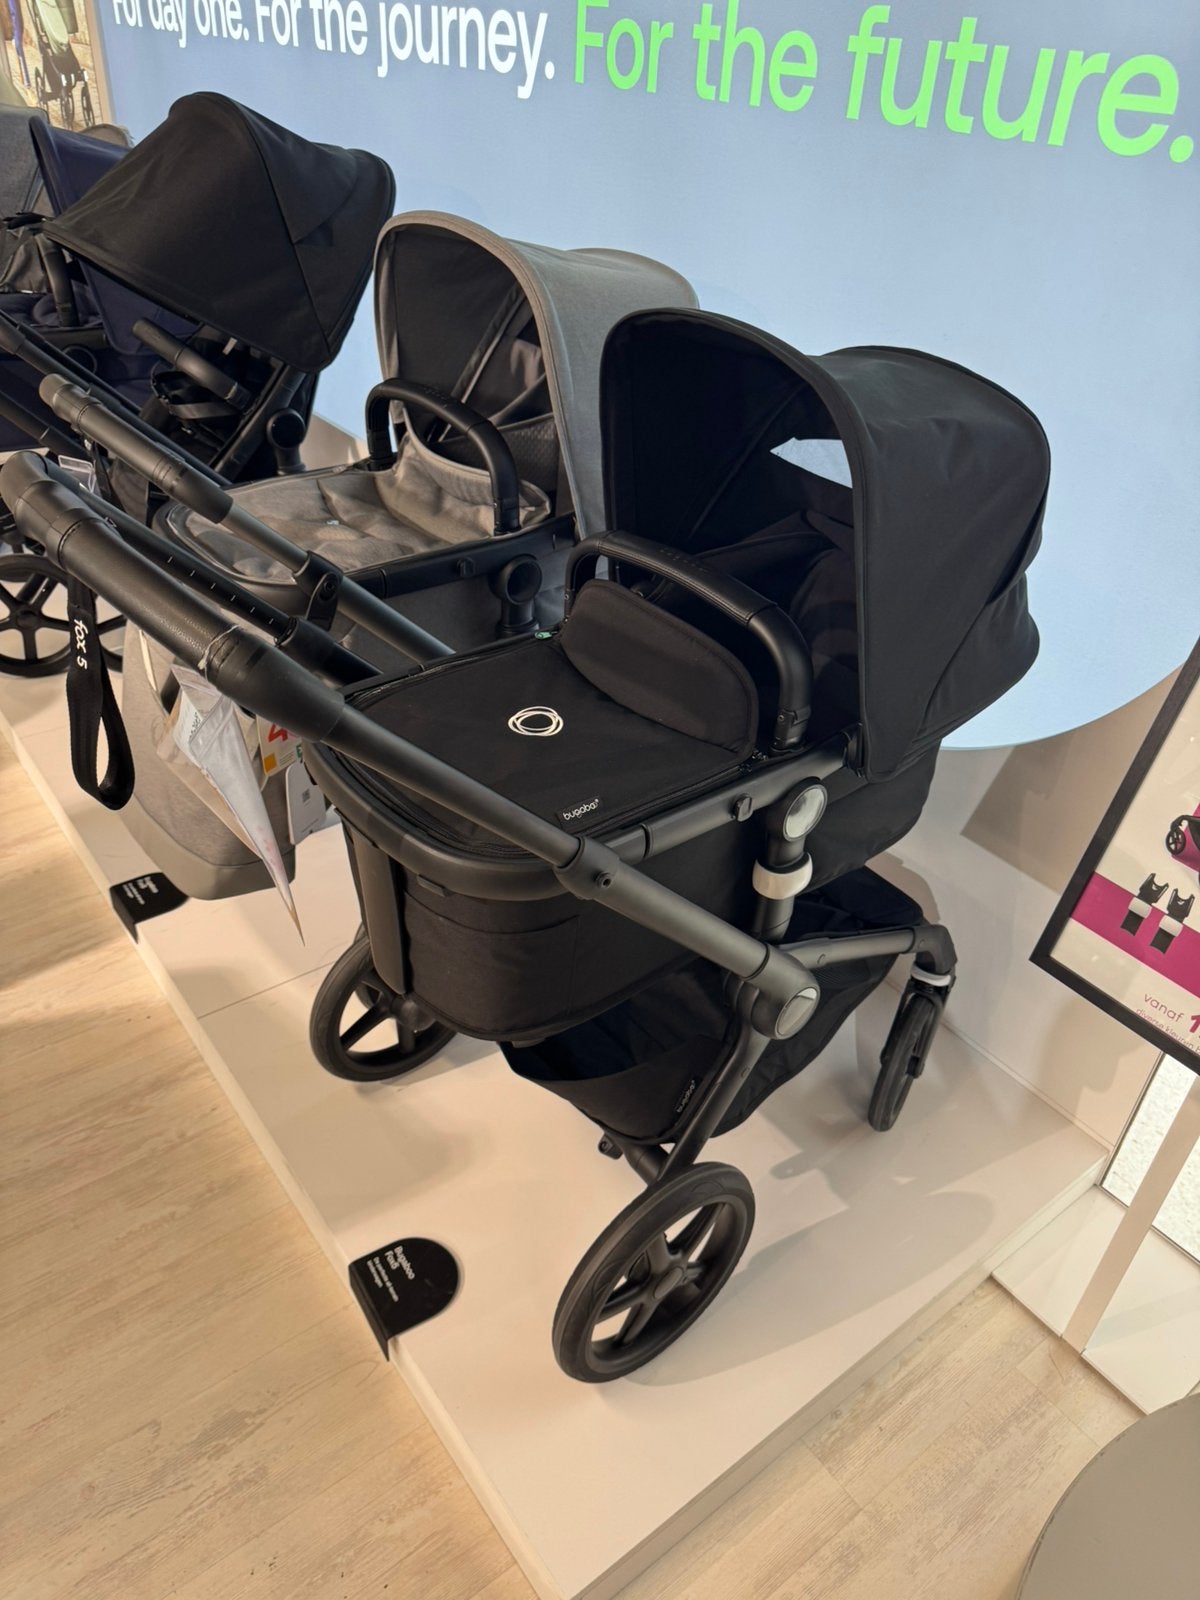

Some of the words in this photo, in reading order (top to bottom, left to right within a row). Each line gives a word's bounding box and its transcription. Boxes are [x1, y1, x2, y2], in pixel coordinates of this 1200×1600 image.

[112, 0, 143, 28] For
[147, 0, 187, 49] day
[193, 0, 250, 41] one.
[254, 0, 302, 48] For
[309, 0, 368, 56] the
[377, 0, 555, 100] journey.
[574, 0, 674, 94] For
[692, 0, 818, 112] the
[845, 4, 1195, 164] future.
[74, 618, 89, 654] fox
[76, 655, 88, 670] 5
[1144, 993, 1185, 1023] vanaf
